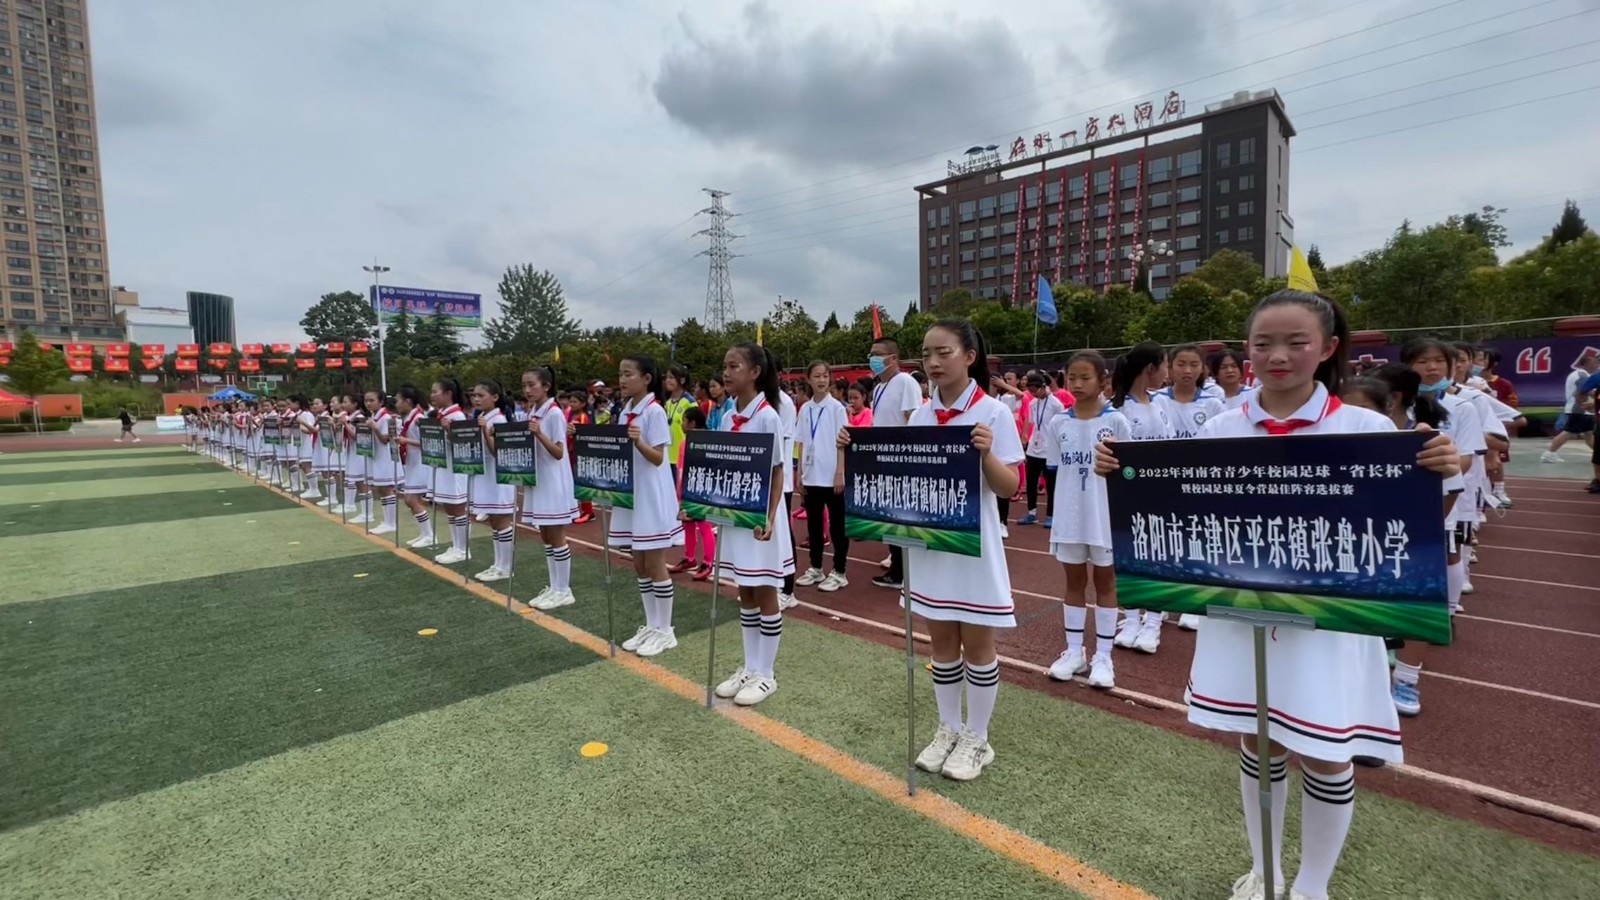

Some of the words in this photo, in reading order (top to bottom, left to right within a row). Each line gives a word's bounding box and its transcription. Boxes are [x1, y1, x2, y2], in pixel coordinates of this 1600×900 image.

[1008, 90, 1180, 160] 在水一方大酒店
[687, 465, 762, 503] 济源市太行路学校
[1078, 467, 1089, 492] 7
[1139, 463, 1413, 480] 2022年河南省青少年校园足球“省长杯”
[1181, 483, 1355, 496] 暨校园足球夏令营最佳阵容选拔赛
[853, 472, 968, 518] 新乡市牧野区牧野镇杨岗小学
[1130, 511, 1411, 580] 洛阳市孟津区平乐镇张盘小学
